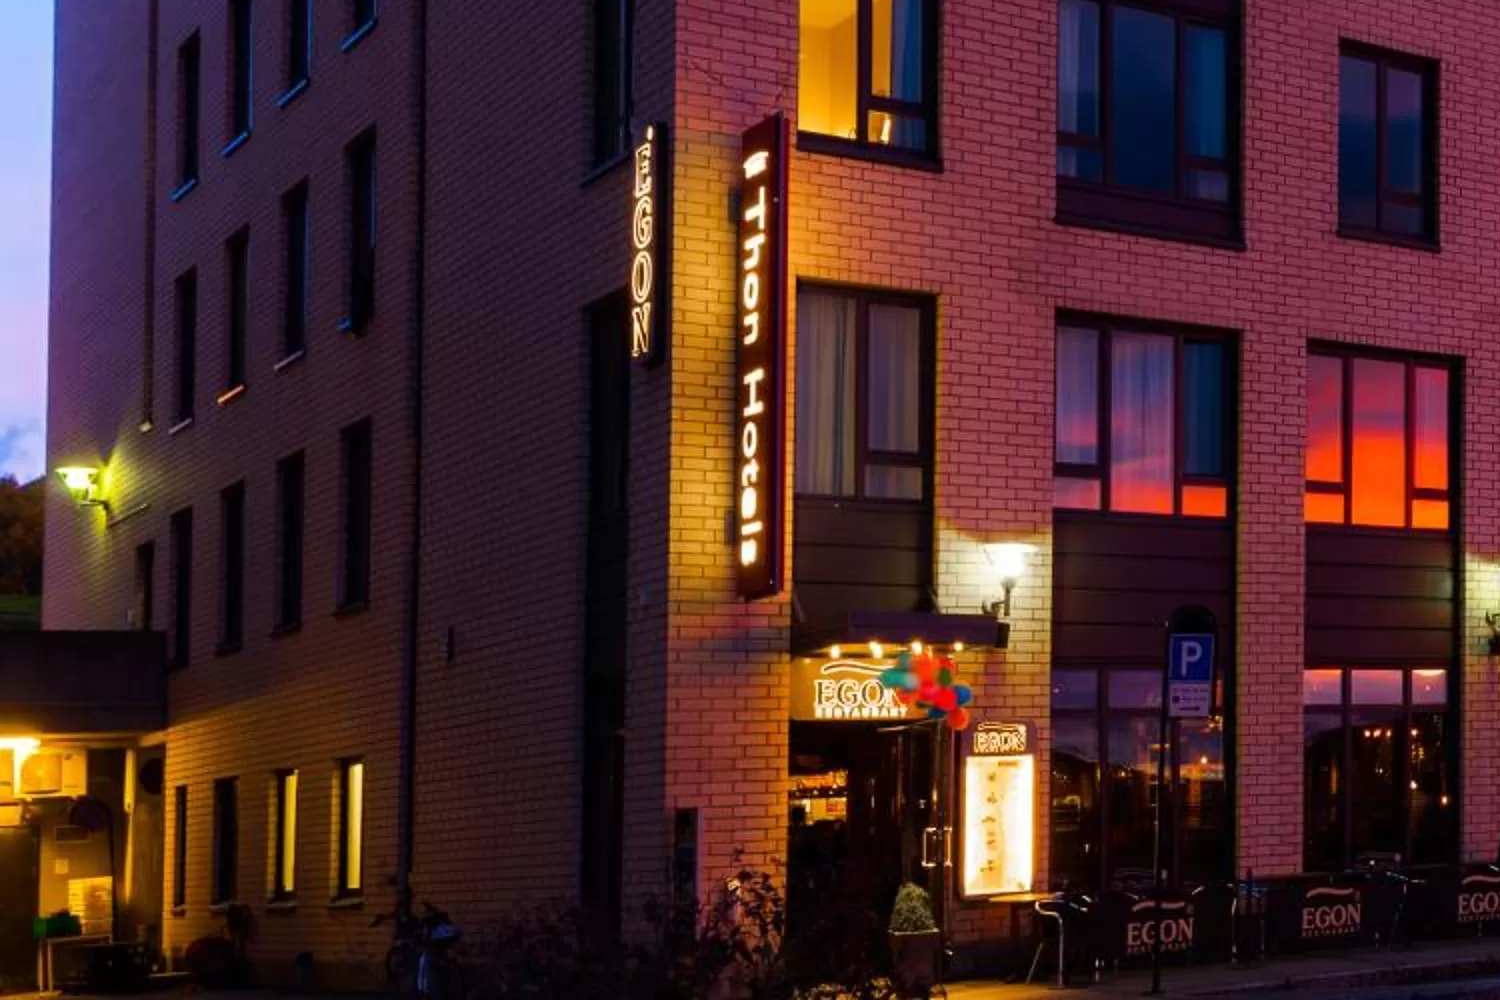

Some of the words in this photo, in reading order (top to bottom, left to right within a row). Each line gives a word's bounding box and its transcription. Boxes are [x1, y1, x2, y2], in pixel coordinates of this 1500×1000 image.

[631, 143, 653, 357] EGON
[743, 186, 766, 345] Thon
[1181, 640, 1203, 678] P
[1127, 916, 1195, 946] EGON
[1301, 903, 1361, 929] EGON
